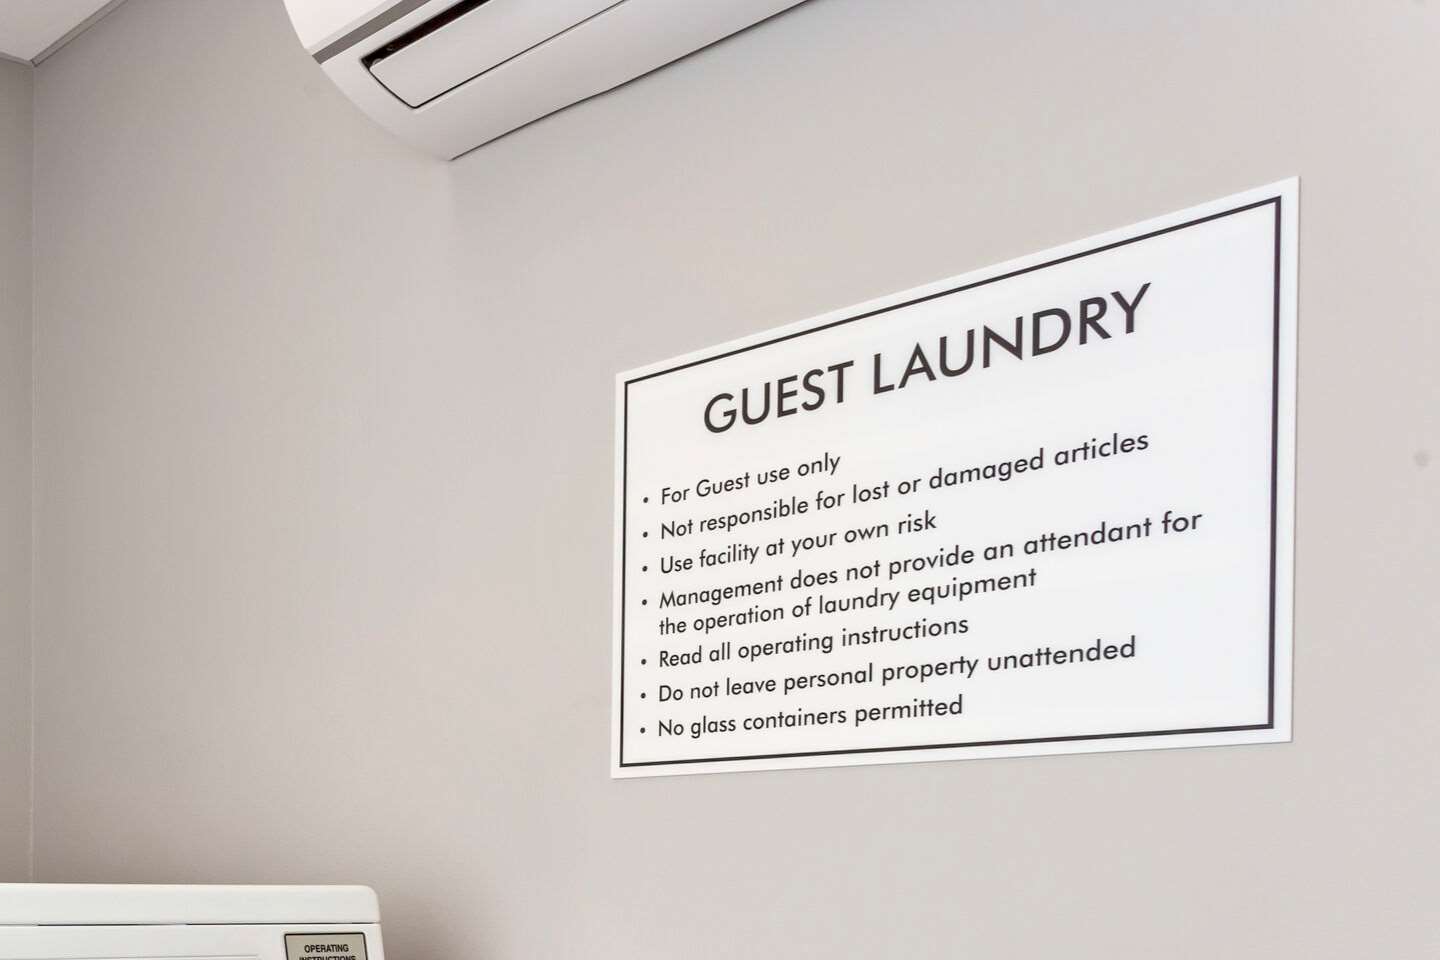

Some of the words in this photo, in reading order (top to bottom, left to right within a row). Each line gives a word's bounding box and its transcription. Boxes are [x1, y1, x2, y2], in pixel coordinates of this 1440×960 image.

[703, 360, 855, 434] GUEST
[873, 282, 1152, 395] LAUNDRY
[661, 487, 691, 505] For
[696, 472, 750, 498] Guest
[757, 467, 790, 485] use
[797, 452, 841, 477] only
[661, 519, 694, 540] Not
[699, 496, 809, 533] responsible
[815, 490, 846, 511] for
[852, 480, 890, 504] lost
[897, 478, 922, 495] or
[929, 447, 1044, 490] damaged
[1054, 432, 1149, 466] articles
[659, 575, 784, 609] Management
[790, 569, 838, 590] does
[846, 559, 881, 581] not
[889, 544, 975, 581] provide
[983, 543, 1014, 561] an
[1023, 517, 1153, 555] attendant
[1161, 510, 1203, 534] for
[660, 555, 694, 574] Use
[699, 543, 760, 568] facility
[765, 537, 785, 557] at
[791, 532, 838, 558] your
[844, 524, 889, 543] own
[898, 509, 937, 535] risk
[658, 617, 687, 636] the
[693, 604, 784, 635] operation
[791, 596, 813, 618] of
[819, 587, 900, 614] laundry
[907, 568, 1037, 605] equipment
[658, 684, 684, 702] Do
[690, 681, 720, 699] not
[726, 677, 777, 696] leave
[784, 662, 873, 696] personal
[882, 655, 979, 687] property
[987, 634, 1136, 671] unattended
[659, 644, 702, 668] Read
[709, 641, 731, 662] all
[737, 632, 833, 662] operating
[842, 617, 969, 647] instructions
[658, 719, 685, 737] No
[690, 715, 737, 739] glass
[743, 707, 847, 731] containers
[855, 693, 963, 728] permitted
[304, 944, 349, 953] OPERATING
